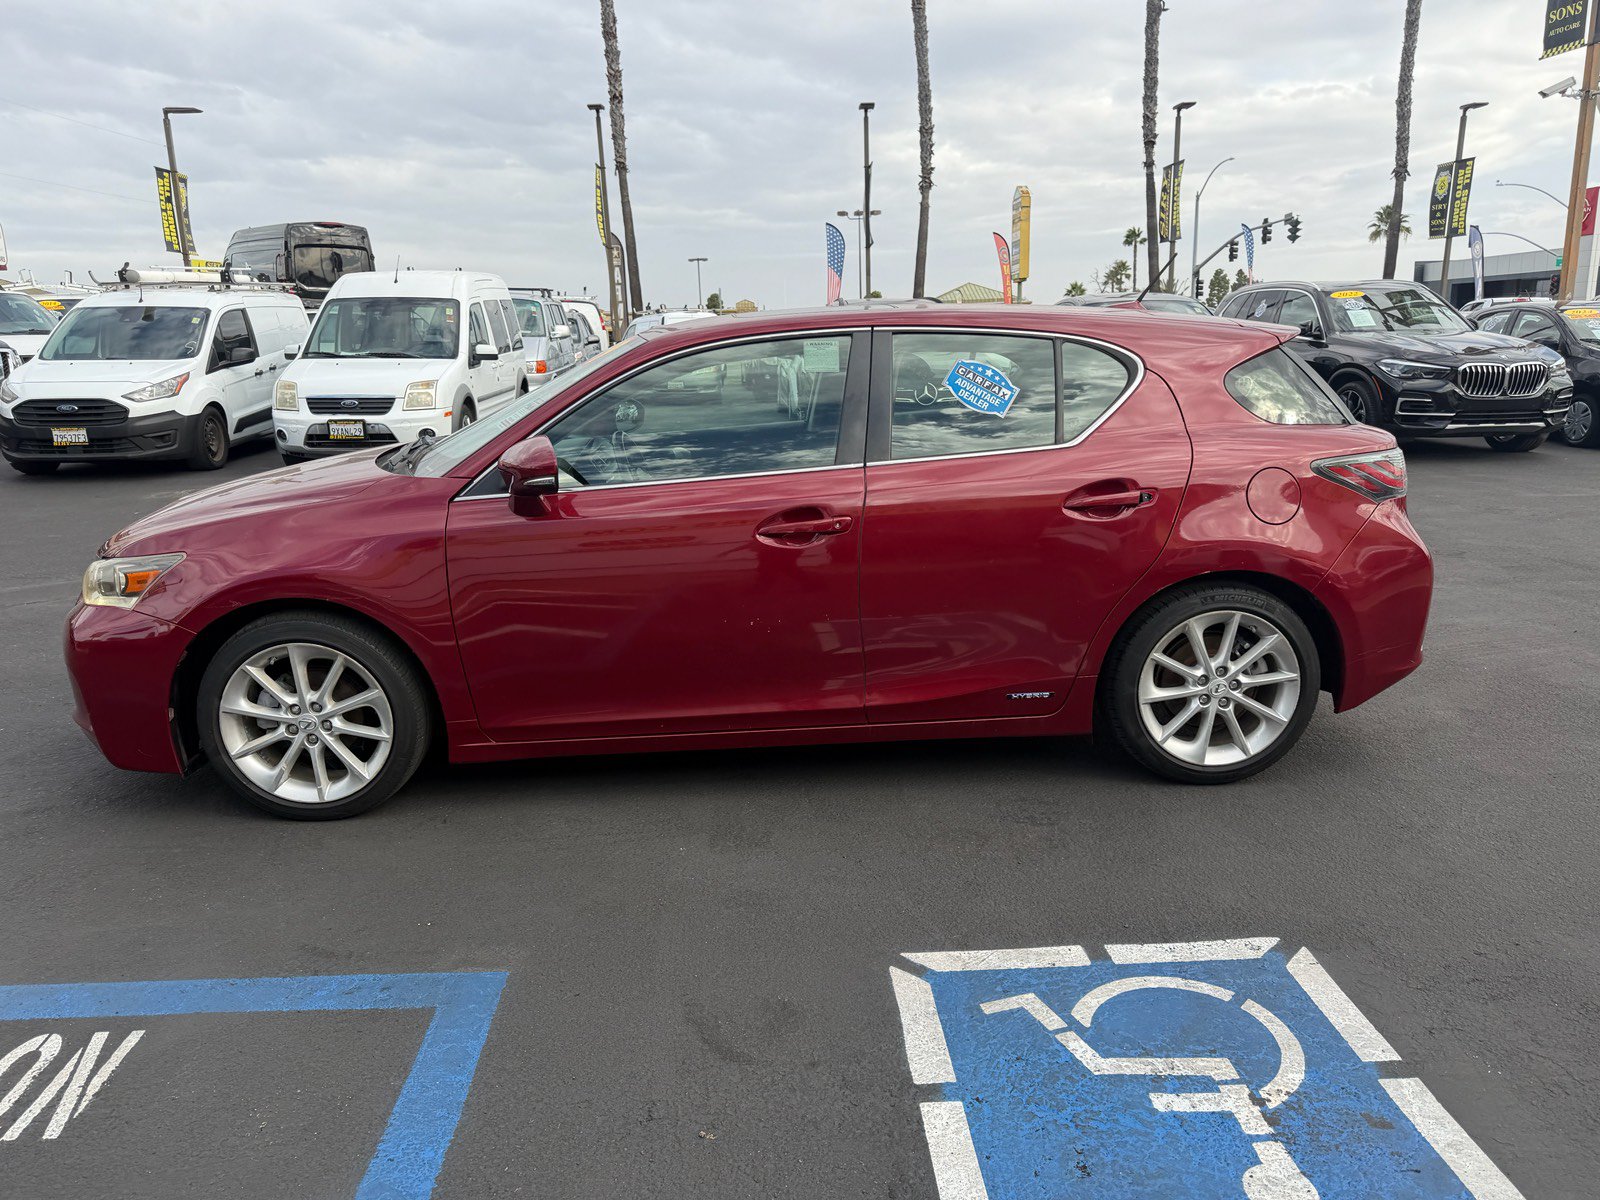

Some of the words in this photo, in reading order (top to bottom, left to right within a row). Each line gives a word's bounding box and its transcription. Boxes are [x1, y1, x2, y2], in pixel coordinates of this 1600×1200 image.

[1548, 0, 1583, 23] SONS
[1548, 26, 1564, 37] AUTO
[1564, 21, 1581, 31] CARE
[163, 171, 171, 197] FULL
[1455, 169, 1464, 198] AUTO
[1465, 160, 1473, 184] FULL
[157, 177, 166, 210] AUTO
[162, 212, 172, 242] CARE
[1452, 199, 1461, 228] CARE
[1458, 189, 1469, 234] SERVICE
[166, 203, 179, 250] SERVICE
[954, 377, 1003, 407] ADVANTAGE
[957, 366, 1009, 399] CARFAX
[958, 389, 989, 411] DEALER
[1214, 594, 1265, 609] MICHELIN
